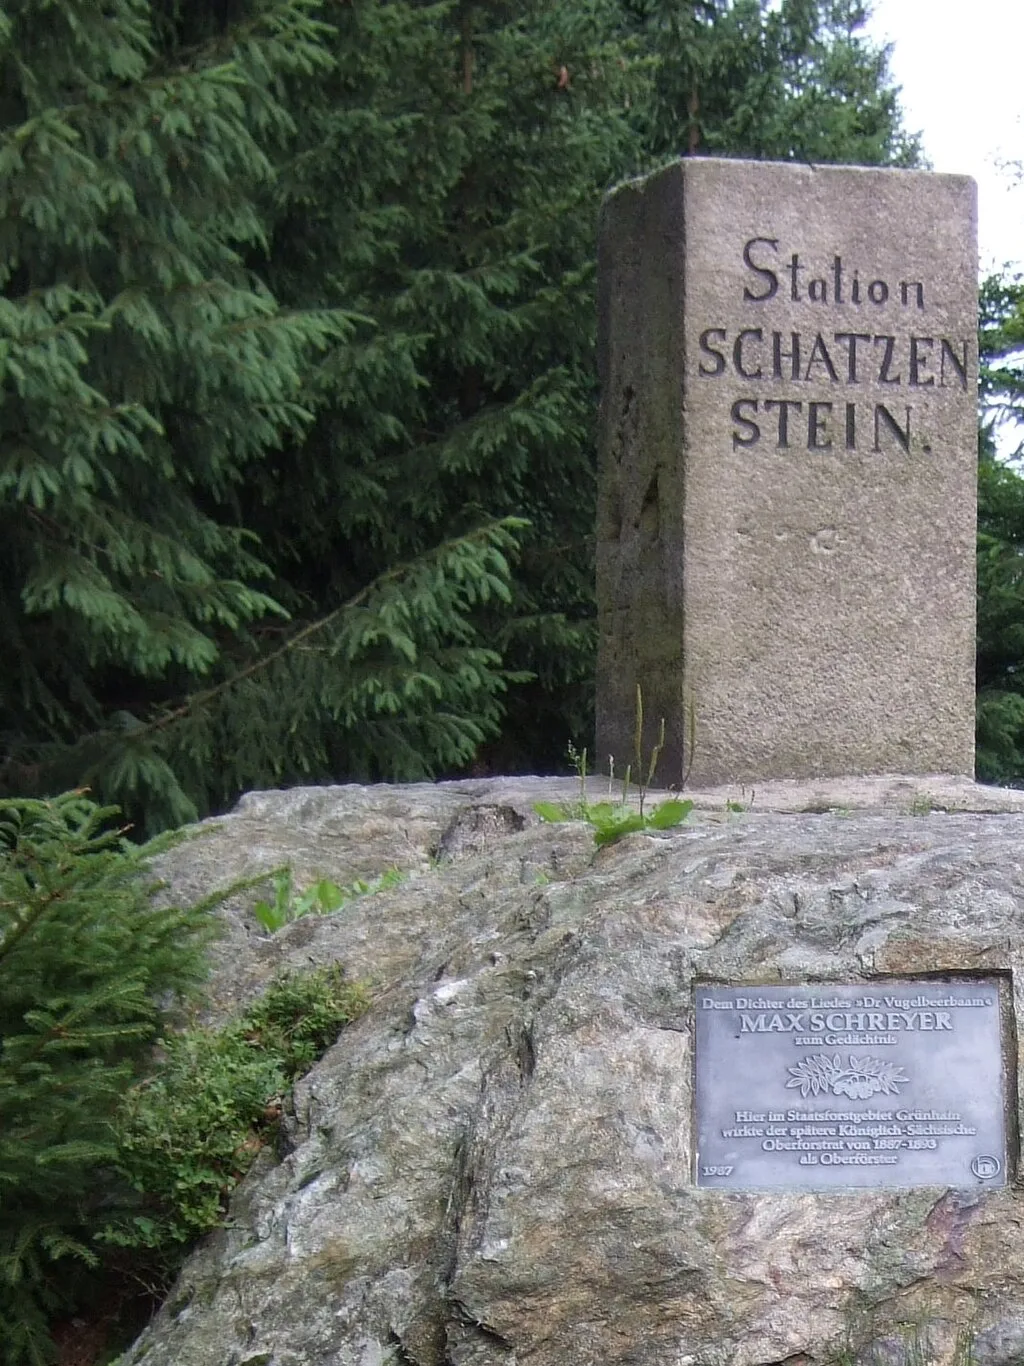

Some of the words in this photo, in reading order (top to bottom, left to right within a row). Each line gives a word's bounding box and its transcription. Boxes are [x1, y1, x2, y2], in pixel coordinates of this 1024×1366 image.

[743, 236, 924, 310] Station
[699, 328, 969, 391] SCHATZEN
[702, 998, 733, 1009] Dem
[736, 998, 784, 1009] Dichter
[787, 998, 808, 1009] des
[811, 997, 851, 1009] Liedes
[741, 1013, 804, 1032] MAX
[810, 1011, 953, 1032] SCHREYER
[795, 1036, 823, 1045] zum
[825, 1034, 897, 1045] Gedächtnis
[736, 1111, 765, 1122] Hier
[768, 1111, 785, 1122] im
[787, 1110, 892, 1124] Staatsforstgebiet
[896, 1110, 961, 1121] Grünhain
[722, 1126, 763, 1137] wirkte
[766, 1125, 787, 1136] der
[790, 1125, 836, 1138] spätere
[838, 1124, 977, 1138] Königlich-Sächsische
[762, 1139, 844, 1151] Oberforstrat
[847, 1141, 871, 1150] von
[800, 1153, 818, 1165] als
[820, 1152, 898, 1165] Oberförster
[703, 1166, 734, 1177] 1987
